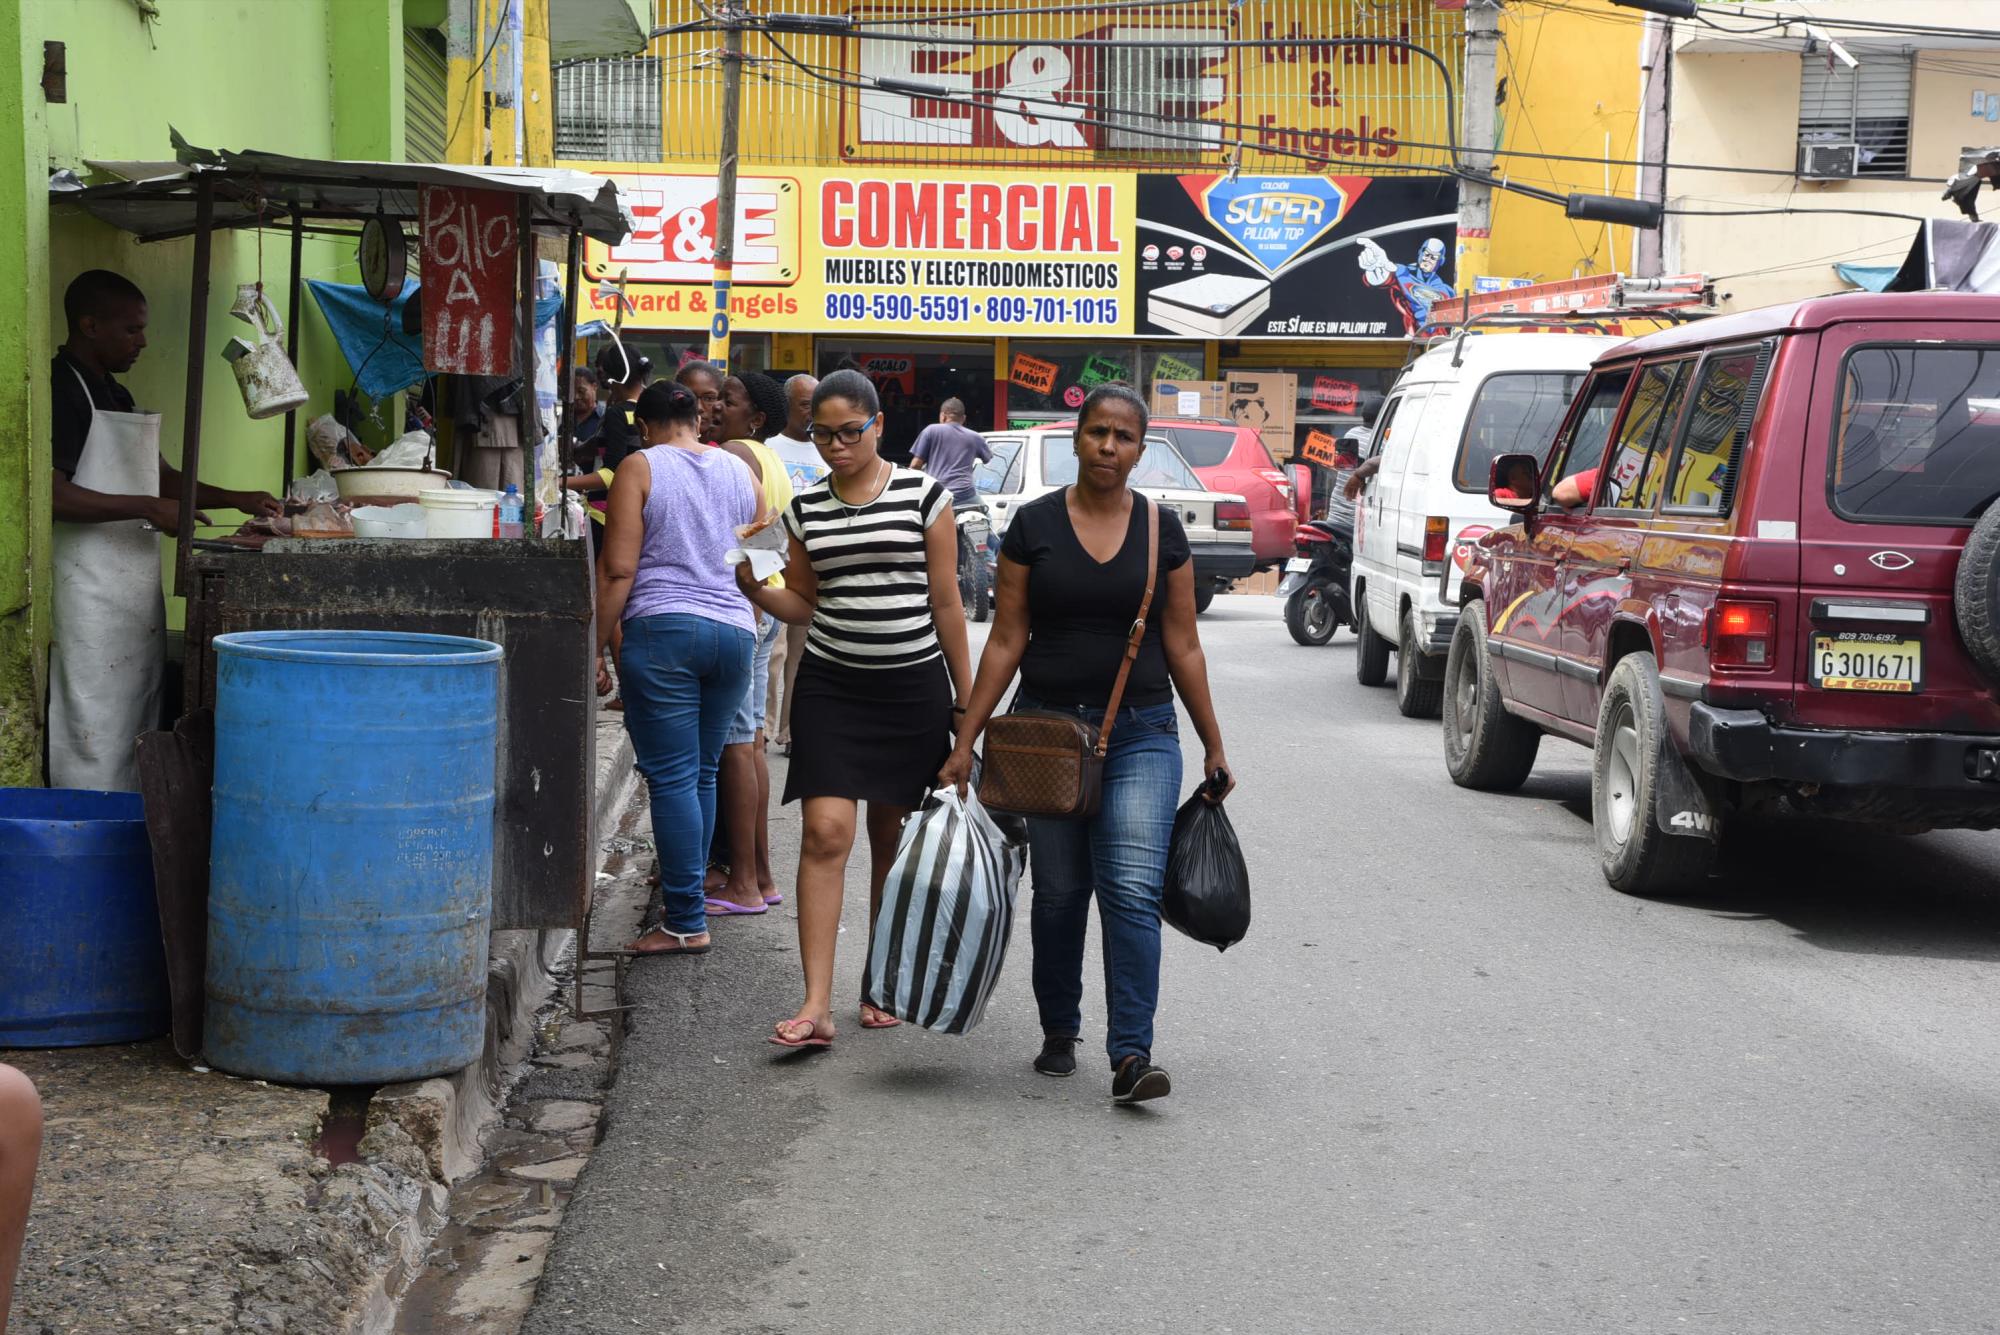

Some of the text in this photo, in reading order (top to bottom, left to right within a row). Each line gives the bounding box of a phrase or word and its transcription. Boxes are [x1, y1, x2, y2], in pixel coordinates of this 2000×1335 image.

[1259, 21, 1410, 65] Edward
[1309, 71, 1343, 107] &
[1257, 116, 1400, 170] Engels
[822, 181, 1119, 252] COMERCIAL
[1224, 192, 1326, 225] SUPER
[423, 185, 511, 278] Pollo
[1243, 227, 1304, 240] PILLOW TOP
[446, 268, 480, 305] A
[826, 259, 1118, 289] MUEBLES Y ELECTRODOMESTICOS
[689, 290, 708, 312] &
[731, 292, 798, 318] ngels
[825, 294, 1117, 324] 809-590-5591 809-701-1015
[1267, 321, 1287, 333] ESTE
[1299, 321, 1315, 334] QUE
[1315, 321, 1326, 333] ES
[1326, 322, 1339, 334] UN
[1339, 322, 1369, 334] PILLOW
[1838, 632, 1897, 642] 809 701-6197
[1822, 651, 1913, 681] G301671
[1823, 677, 1911, 691] La Goma
